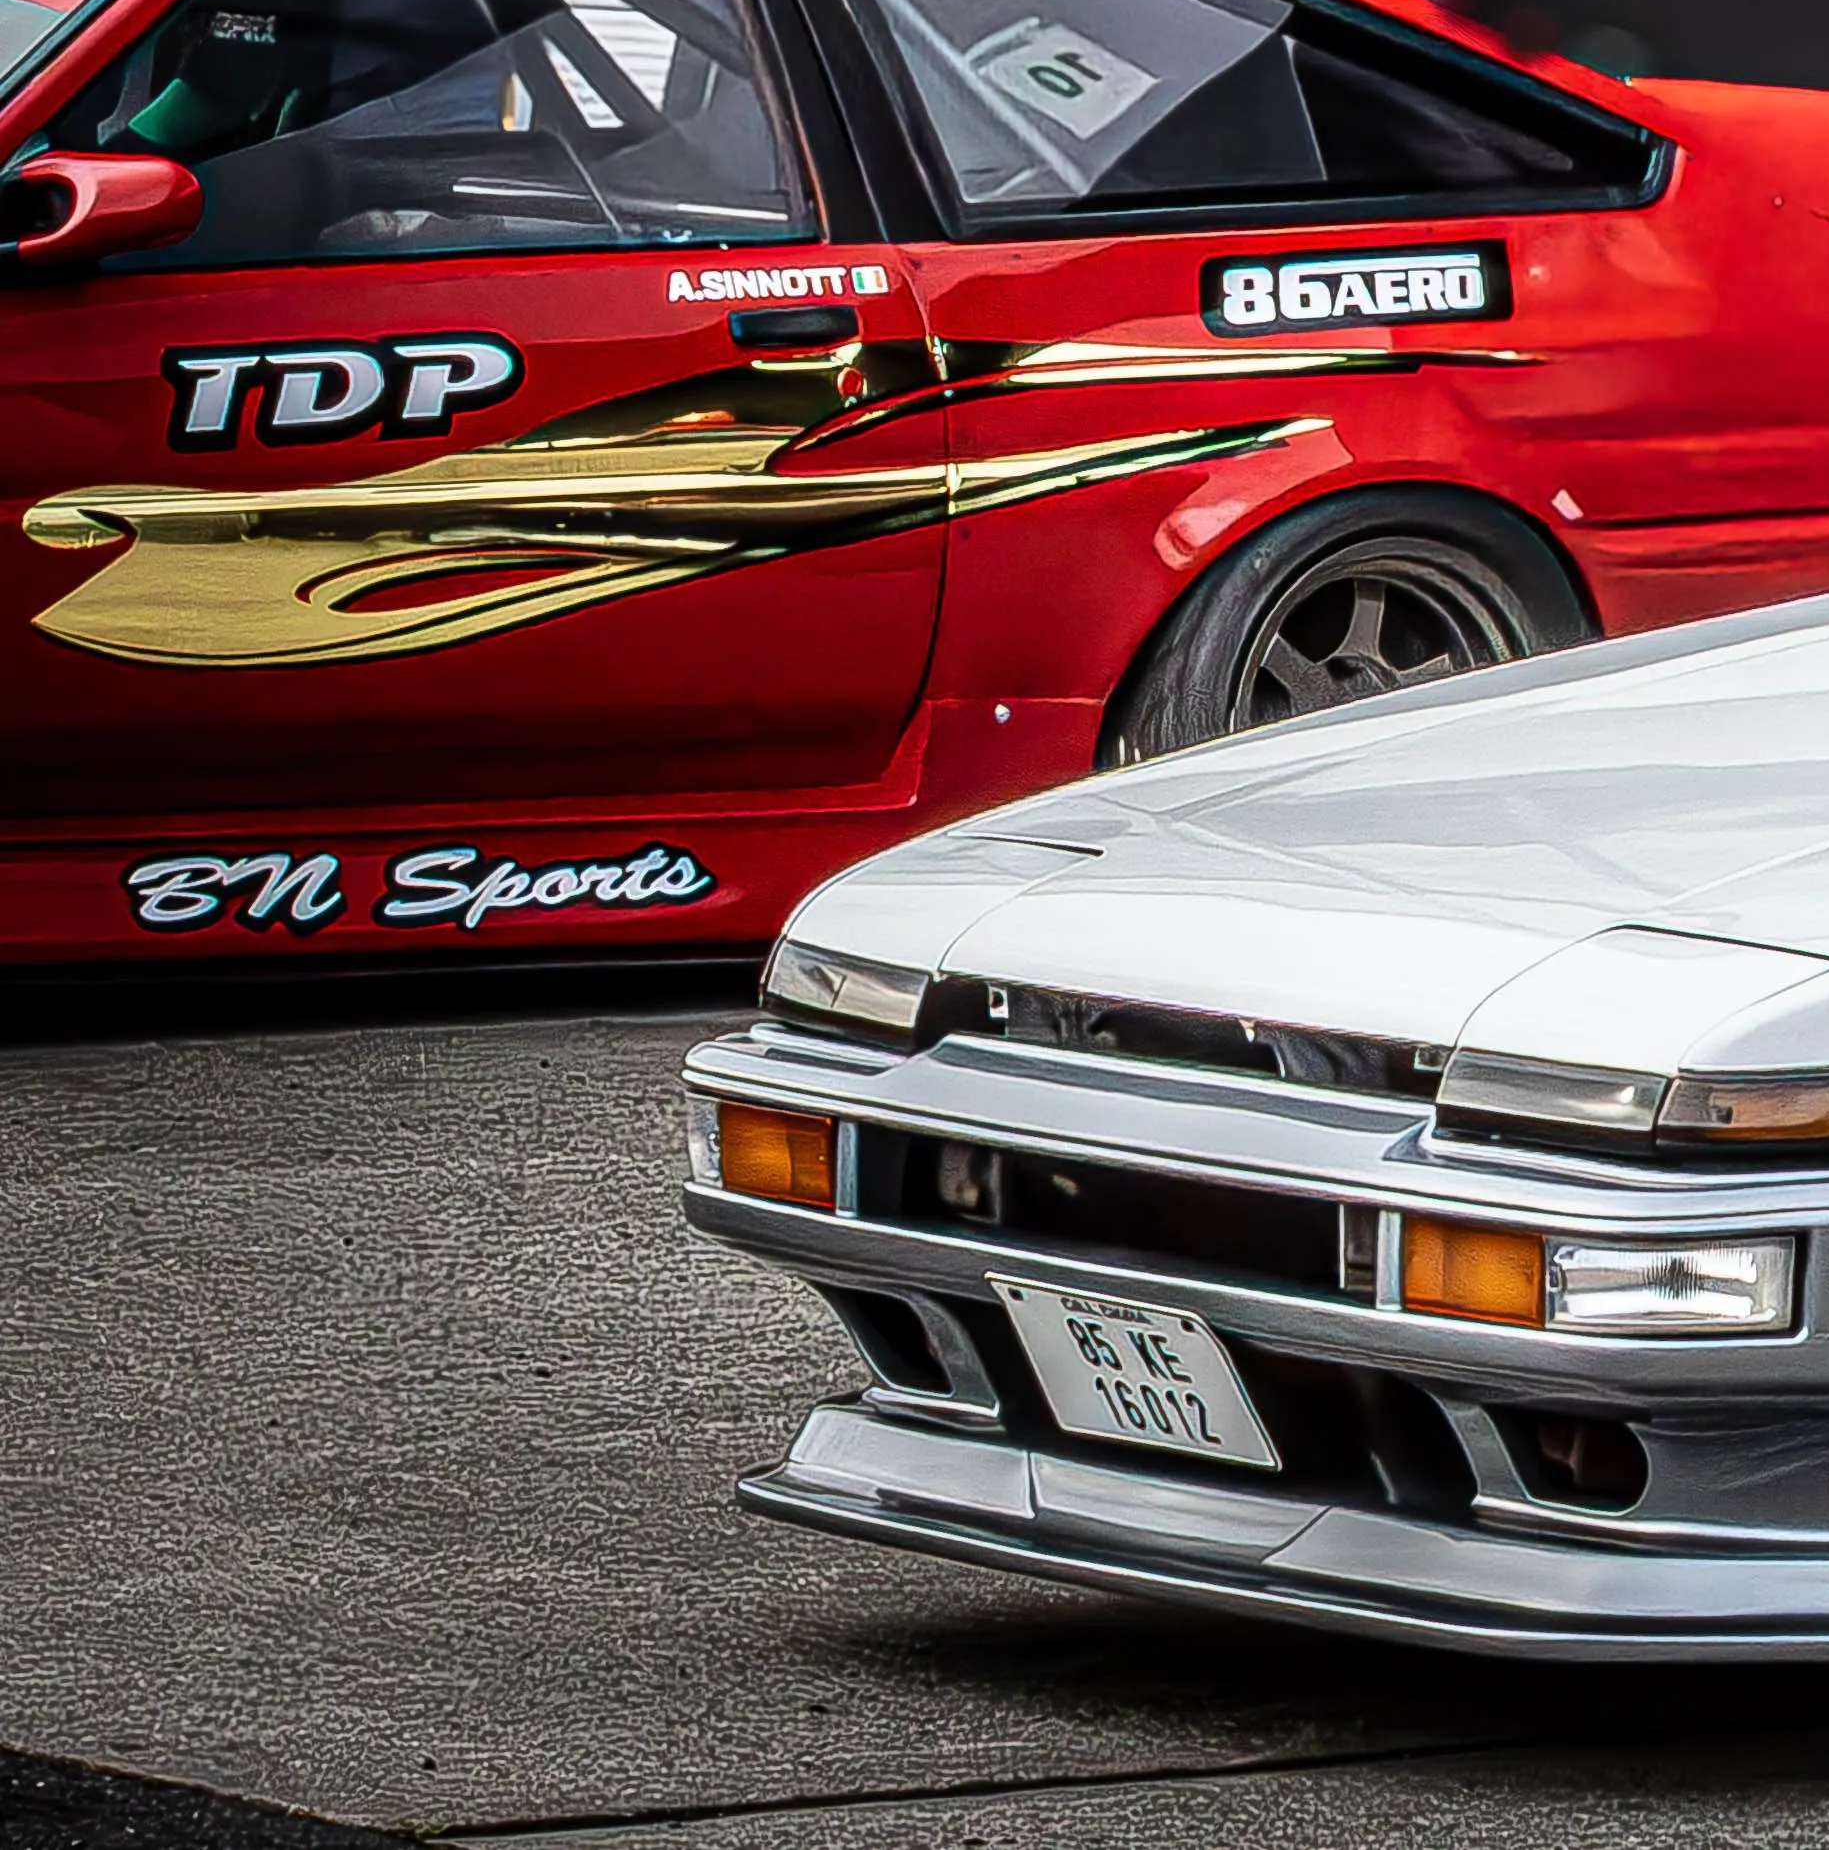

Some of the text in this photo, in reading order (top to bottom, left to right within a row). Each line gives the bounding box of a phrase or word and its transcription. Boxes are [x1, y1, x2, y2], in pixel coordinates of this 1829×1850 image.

[668, 266, 848, 304] A.SINNOTT
[1222, 255, 1486, 325] 86AERO
[178, 343, 513, 432] TDP
[127, 850, 713, 928] BN Sports
[1066, 1318, 1192, 1384] 85 KE
[1094, 1376, 1222, 1446] 16012
